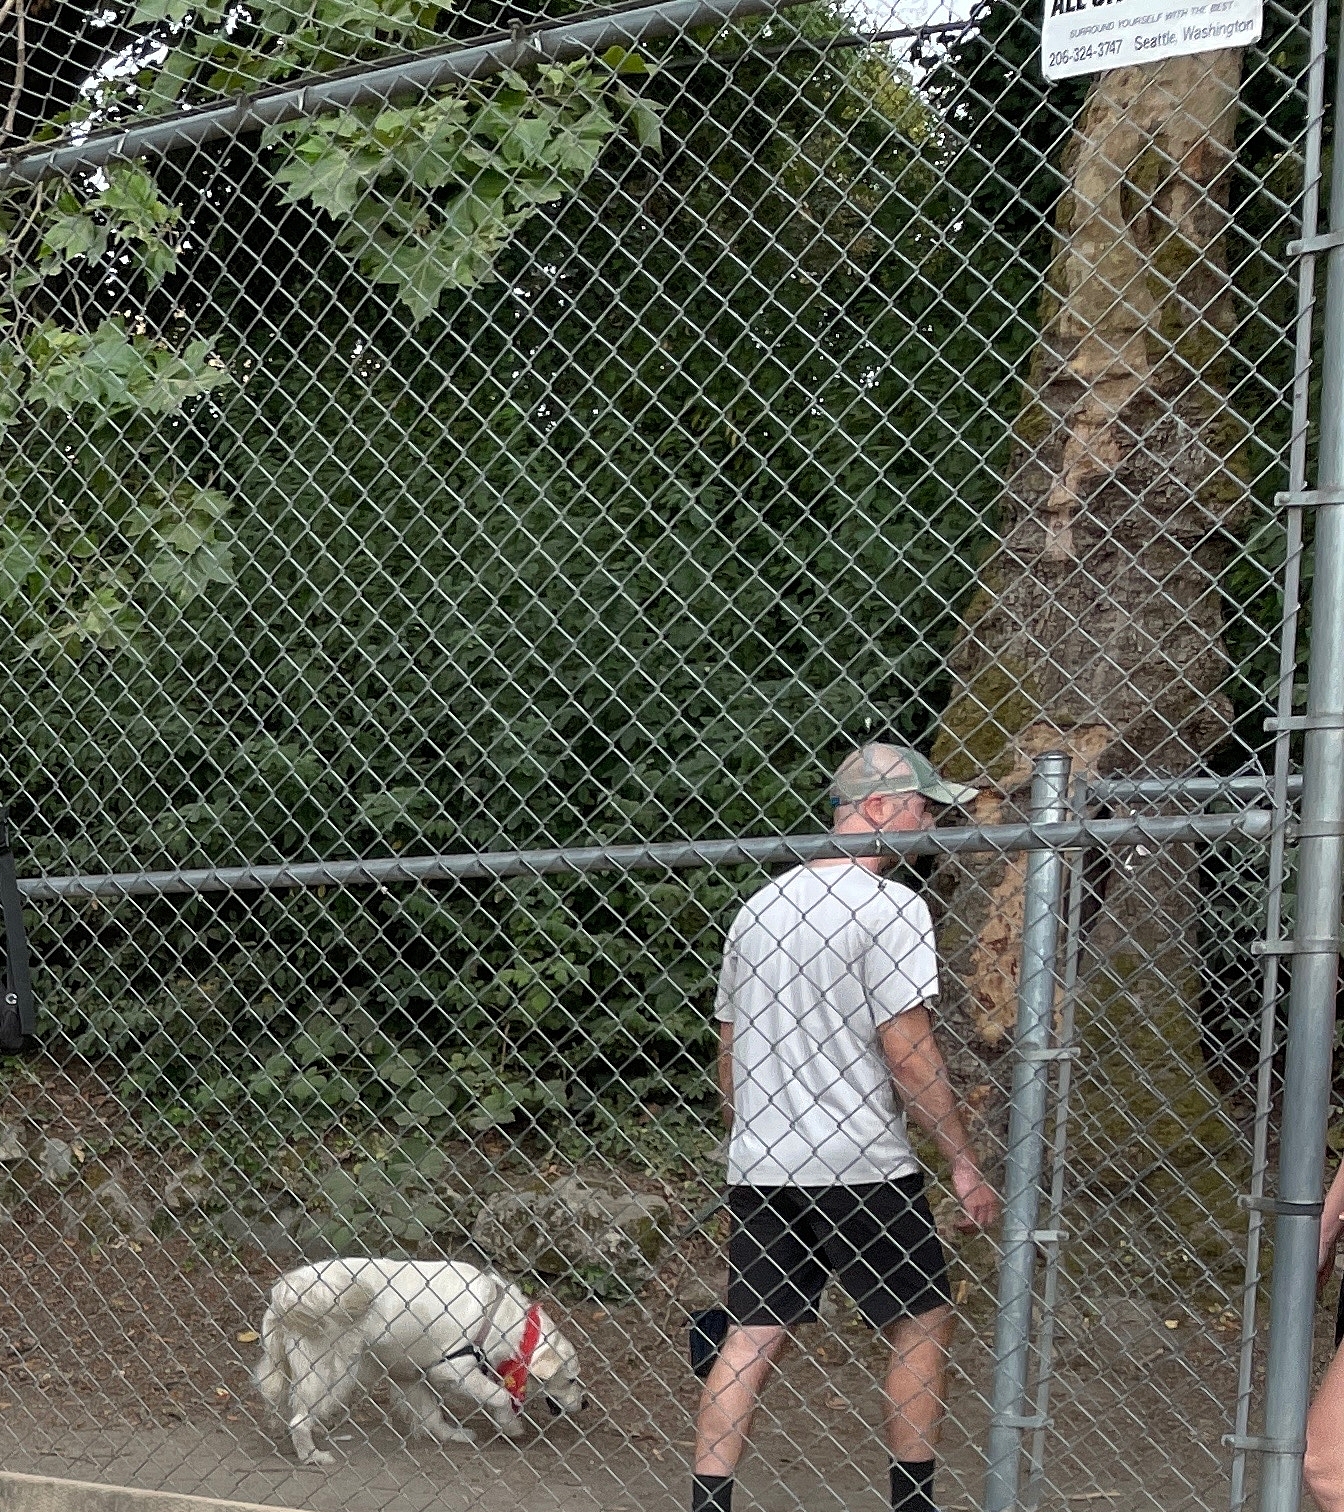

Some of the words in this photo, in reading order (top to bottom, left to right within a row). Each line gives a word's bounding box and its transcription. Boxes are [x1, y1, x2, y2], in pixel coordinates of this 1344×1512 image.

[1069, 21, 1115, 39] SURROUND
[1117, 12, 1163, 29] YOURSELF
[1210, 0, 1235, 13] BEST
[1048, 39, 1123, 68] 206-324-3747
[1134, 30, 1178, 51] Seattle,
[1182, 19, 1254, 42] Washington
